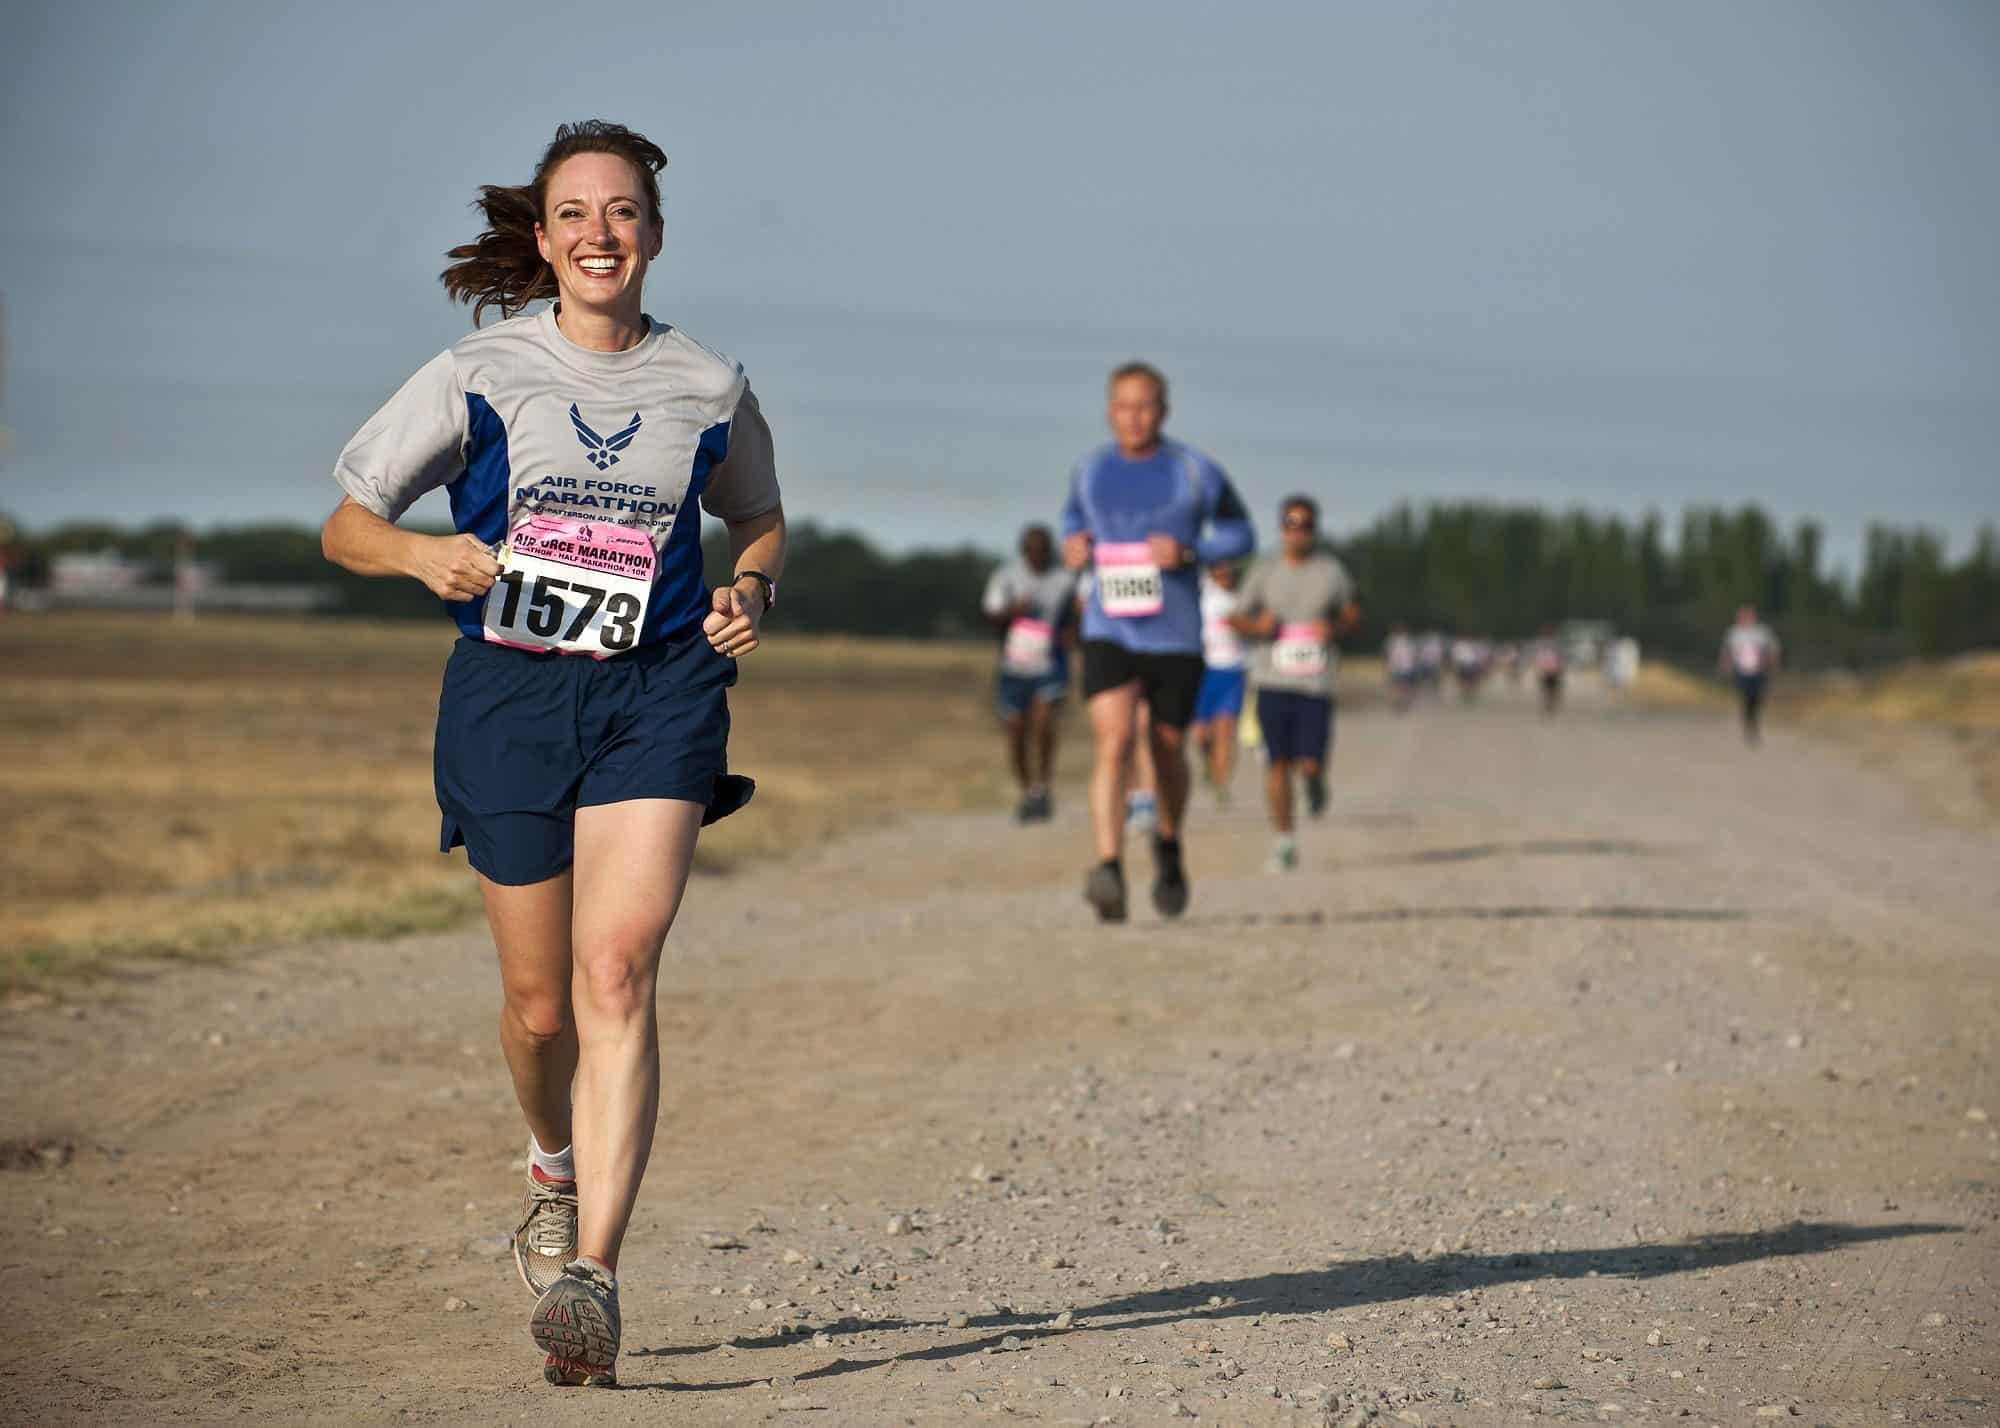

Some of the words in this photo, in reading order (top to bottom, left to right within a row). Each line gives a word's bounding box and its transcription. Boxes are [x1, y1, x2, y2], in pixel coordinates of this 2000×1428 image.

[540, 475, 577, 489] AIR
[585, 480, 657, 497] FORCE
[516, 487, 677, 514] MARATHON
[539, 538, 575, 553] ORCE
[577, 545, 653, 569] MARATHON
[580, 557, 625, 572] MARATHON
[632, 568, 647, 577] 10K
[500, 570, 641, 650] 1573
